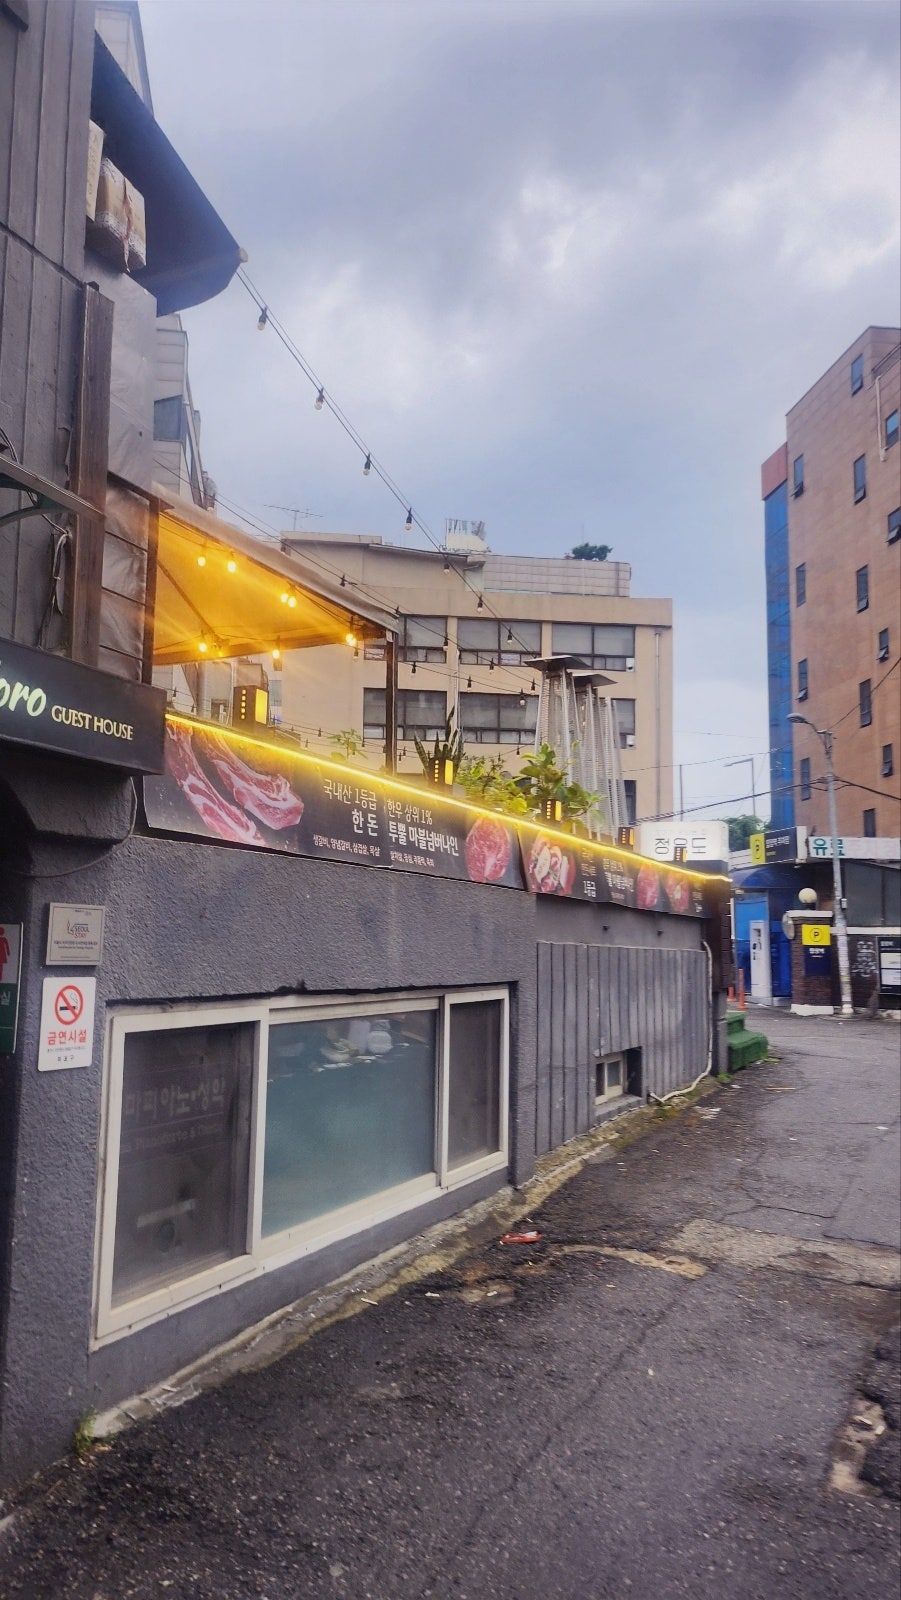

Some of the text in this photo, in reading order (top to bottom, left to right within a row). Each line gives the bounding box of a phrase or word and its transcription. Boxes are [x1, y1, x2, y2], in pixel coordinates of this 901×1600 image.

[51, 705, 92, 730] GUEST
[93, 716, 134, 741] HOUSE
[323, 778, 378, 811] 국내산 1등급
[351, 808, 379, 837] 한 돈
[387, 799, 433, 826] 한우 상위 1%
[388, 820, 460, 857] 투뿔 마블넘버나인
[47, 1029, 87, 1046] 금연시설
